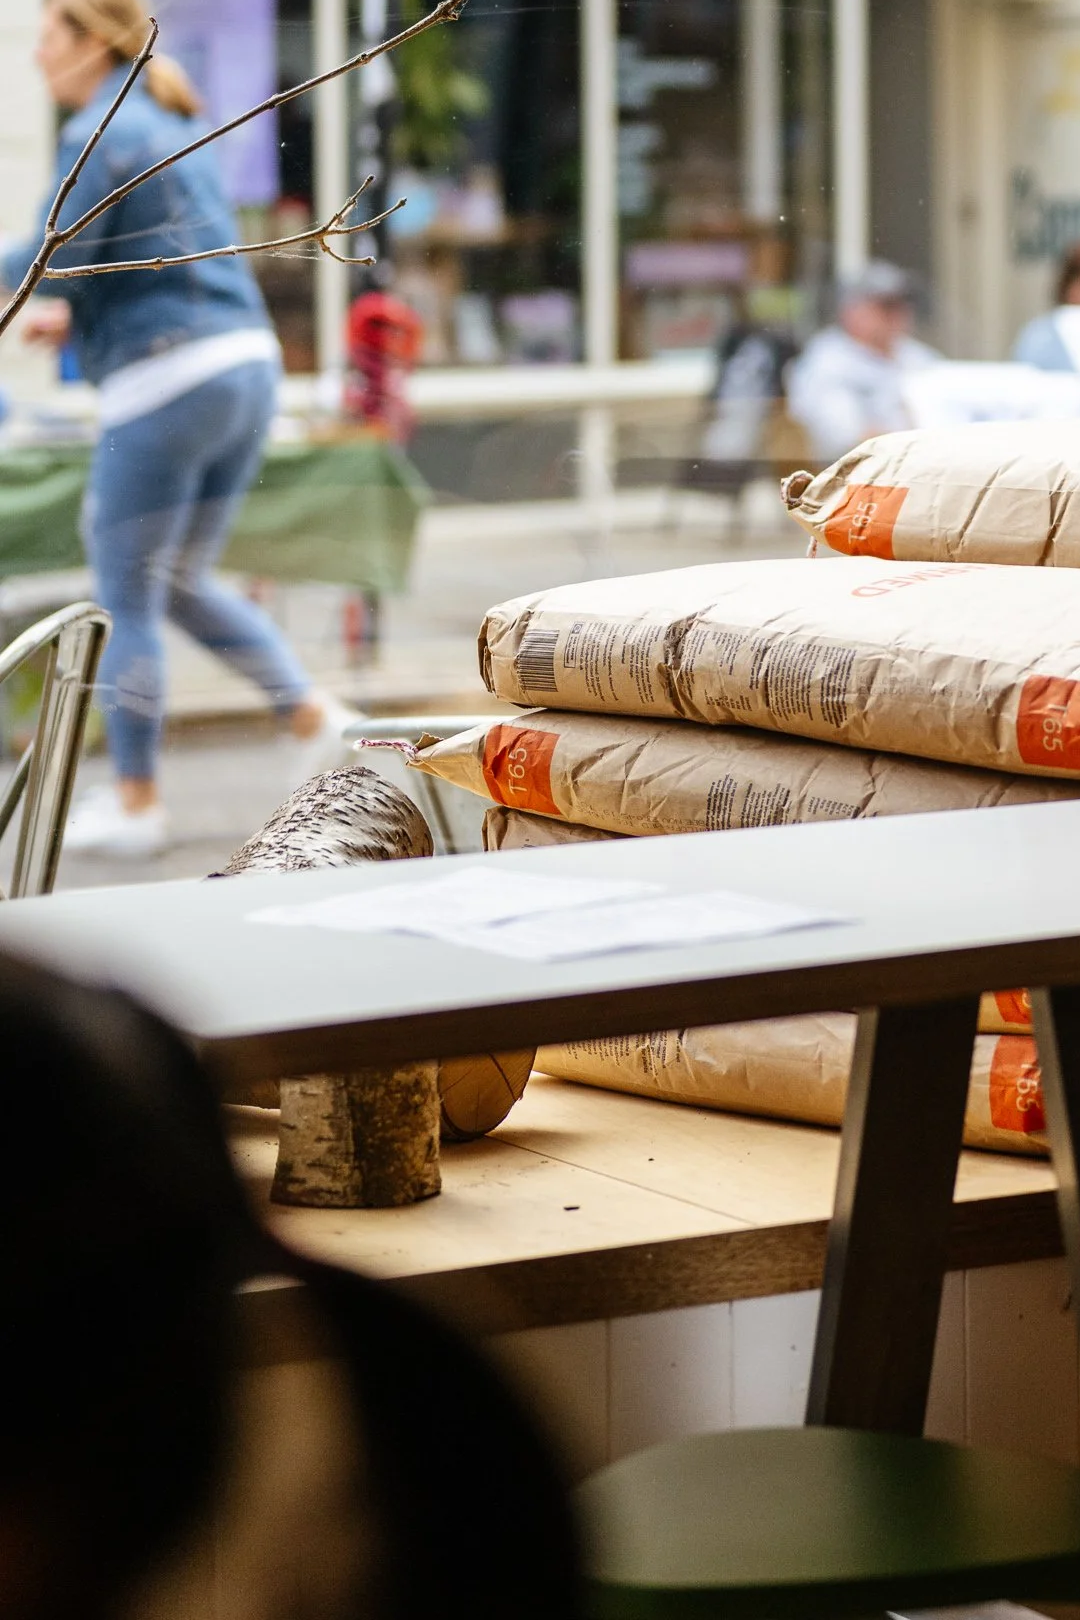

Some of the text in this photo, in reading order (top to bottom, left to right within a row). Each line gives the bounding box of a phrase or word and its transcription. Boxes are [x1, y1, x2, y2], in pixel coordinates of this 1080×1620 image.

[848, 500, 877, 544] T65
[1042, 703, 1068, 751] T65
[508, 747, 527, 795] T65
